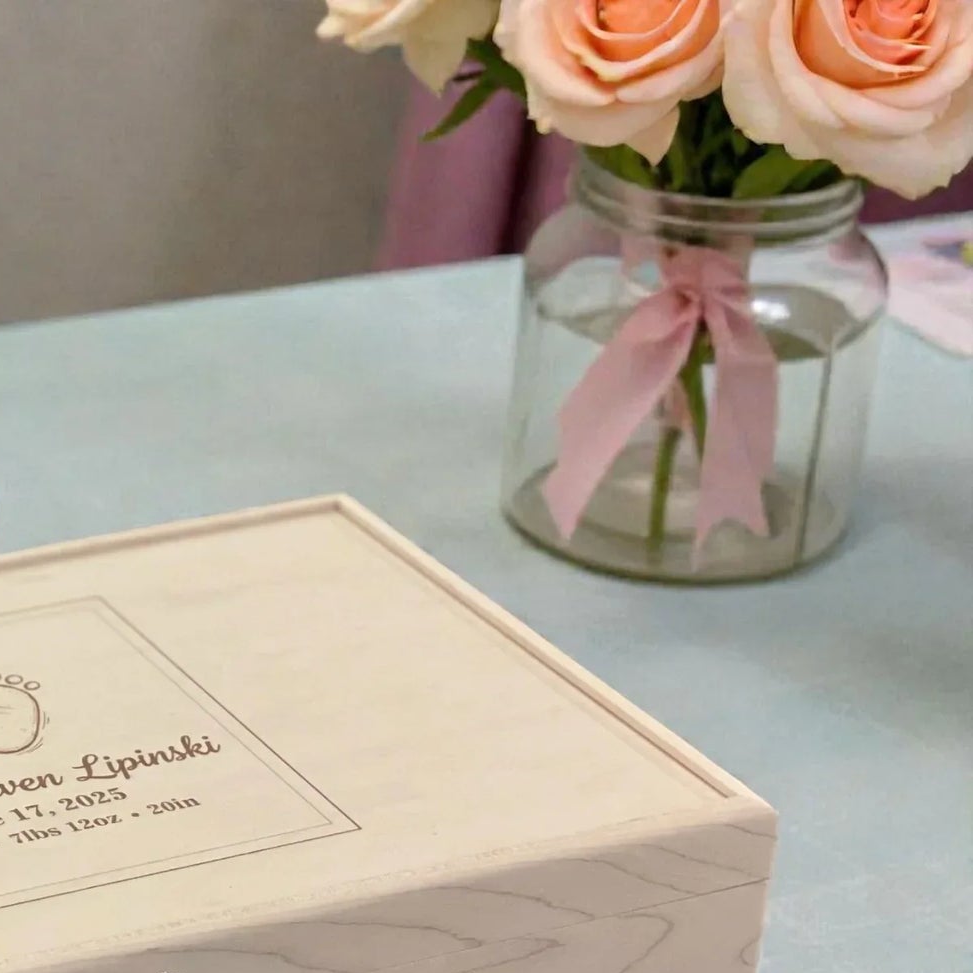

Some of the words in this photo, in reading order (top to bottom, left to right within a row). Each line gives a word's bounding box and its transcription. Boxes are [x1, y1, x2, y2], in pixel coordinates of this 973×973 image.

[71, 735, 221, 781] Lipinski
[8, 826, 63, 844] 7lbs
[65, 814, 123, 833] 12oz
[146, 797, 201, 815] 20in
[9, 804, 57, 823] 17,
[57, 787, 128, 812] 2025
